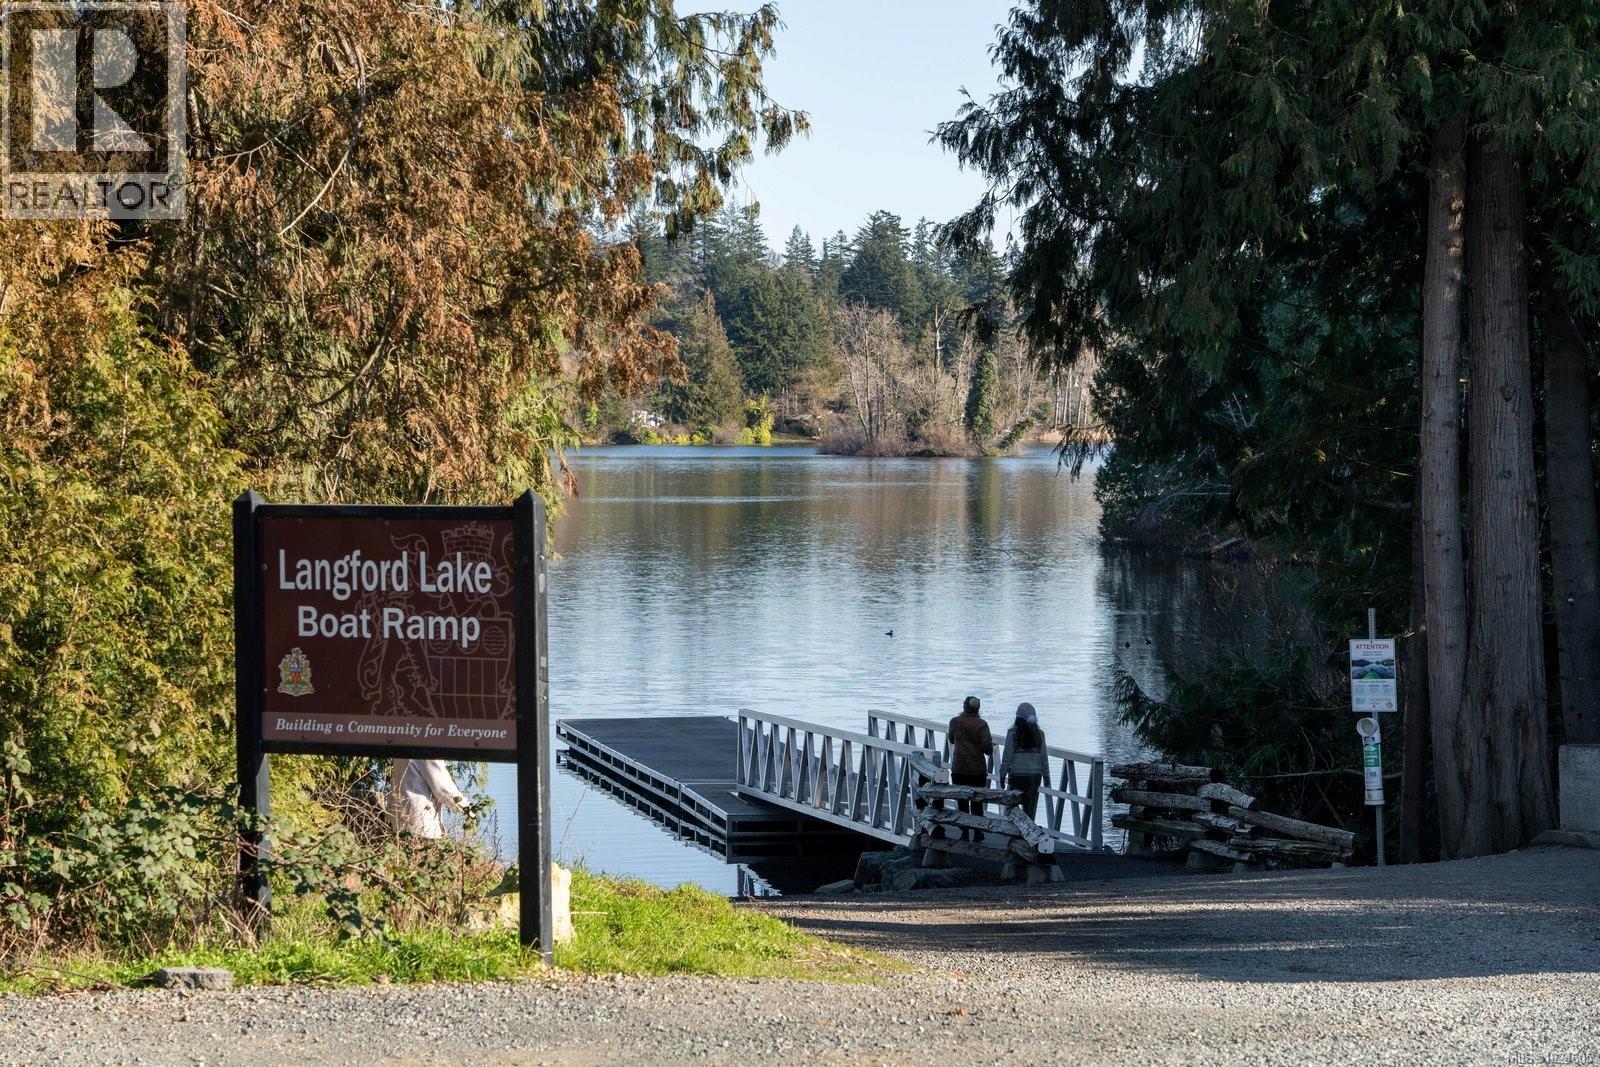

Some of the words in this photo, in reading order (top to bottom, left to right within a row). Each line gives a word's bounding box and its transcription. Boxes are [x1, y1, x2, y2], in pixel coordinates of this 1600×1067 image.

[278, 548, 409, 601] Langford
[419, 551, 493, 594] Lake
[297, 605, 372, 639] Boat
[382, 607, 481, 648] Ramp
[275, 718, 332, 735] Building
[335, 723, 344, 733] a
[347, 720, 422, 738] Community
[424, 722, 445, 739] for
[447, 725, 507, 741] Everyone
